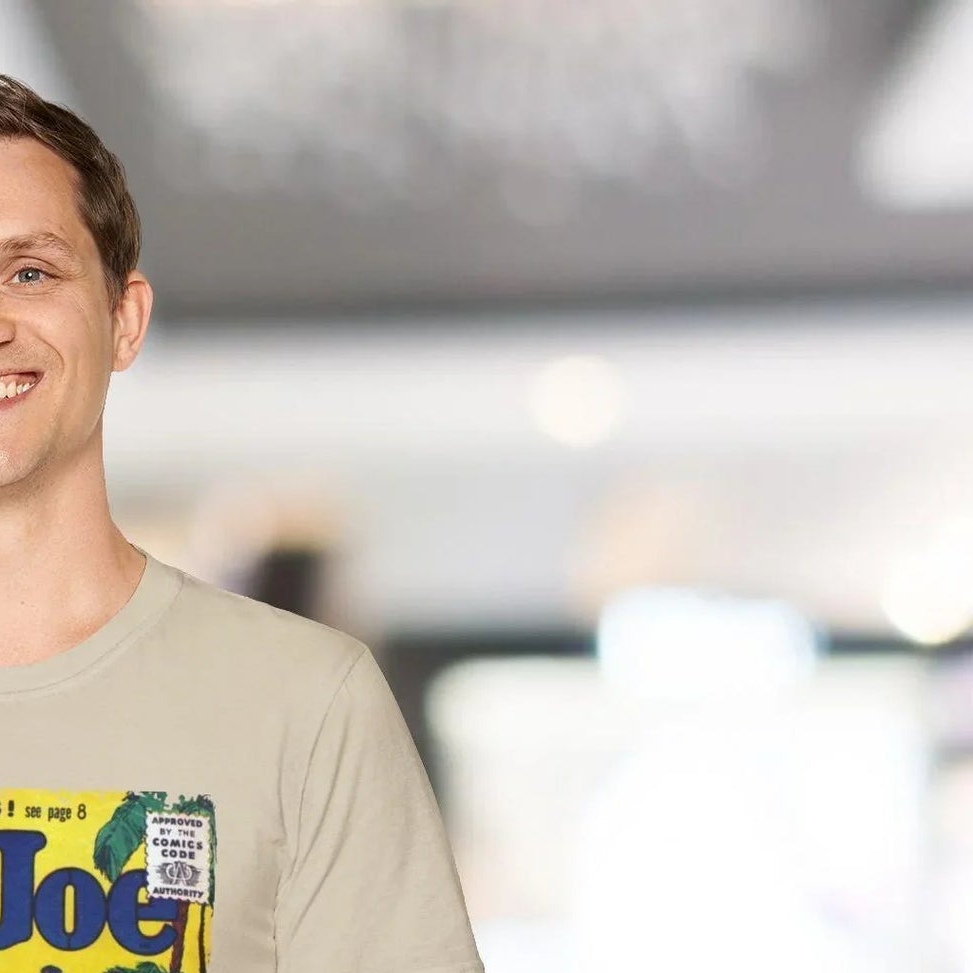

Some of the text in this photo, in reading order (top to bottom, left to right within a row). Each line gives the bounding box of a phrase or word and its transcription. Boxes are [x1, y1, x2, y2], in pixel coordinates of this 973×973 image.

[24, 804, 87, 822] see page 8
[152, 817, 203, 828] APPROVED
[159, 828, 195, 837] BY THE
[152, 838, 203, 850] COMICS
[161, 849, 195, 860] CODE
[153, 887, 204, 898] AUTHORITY
